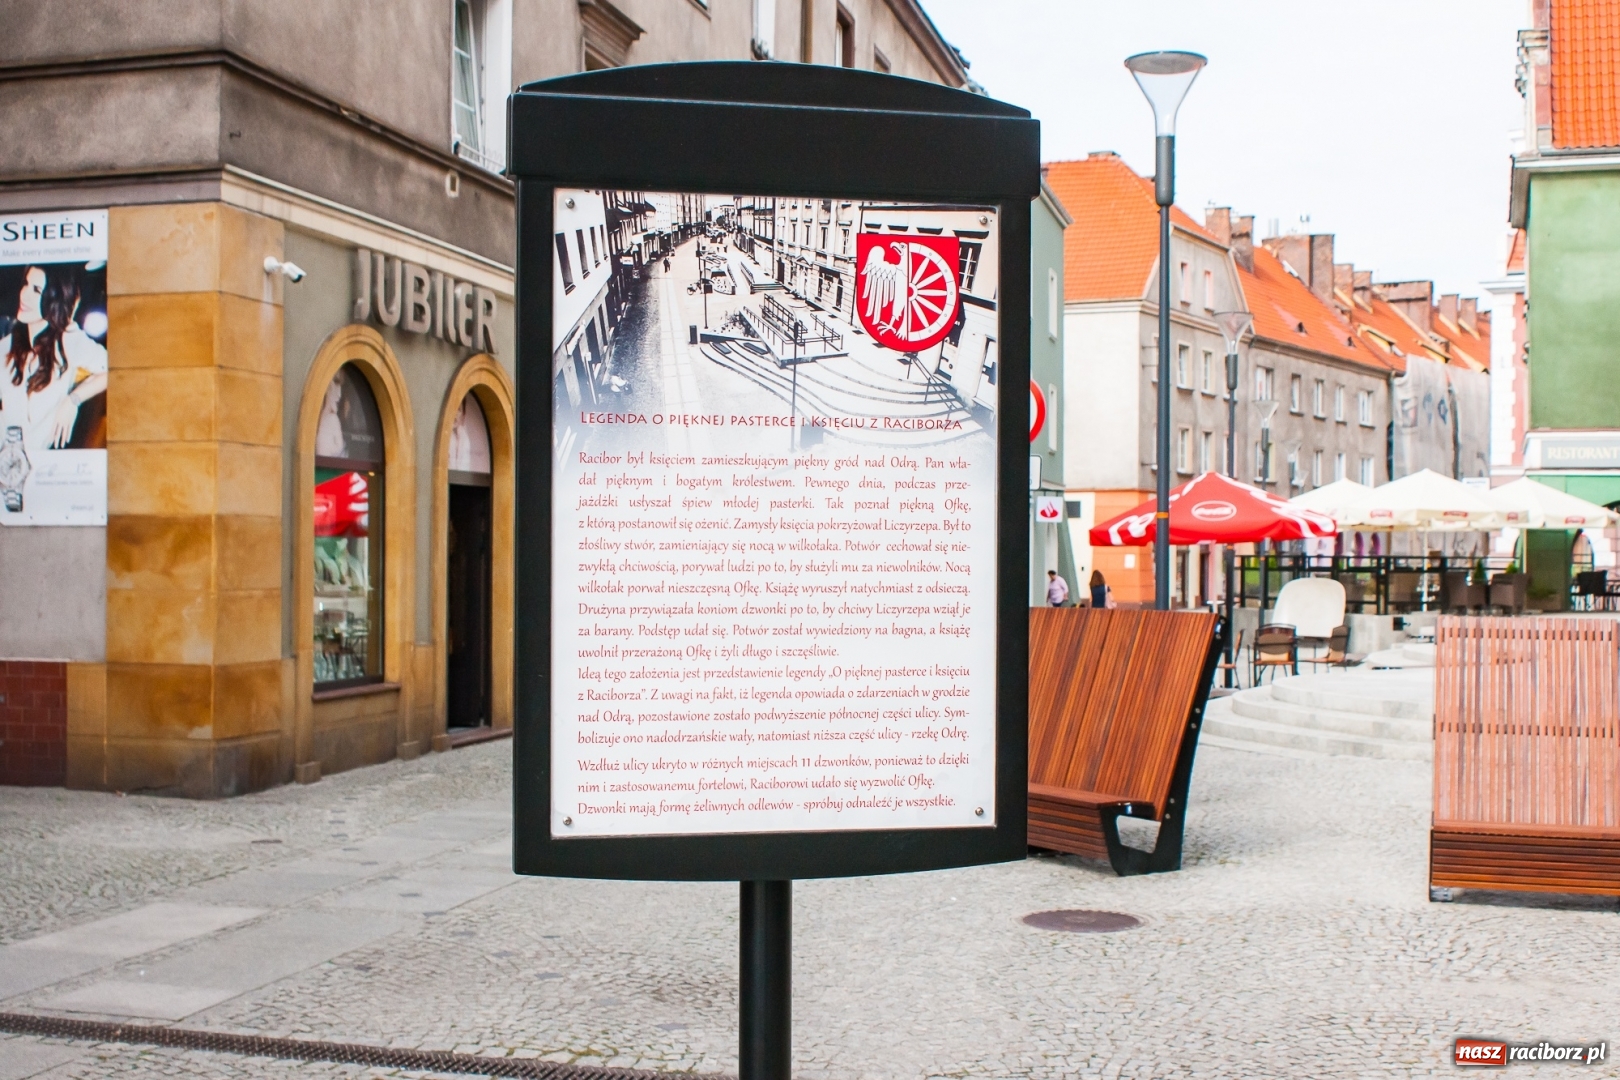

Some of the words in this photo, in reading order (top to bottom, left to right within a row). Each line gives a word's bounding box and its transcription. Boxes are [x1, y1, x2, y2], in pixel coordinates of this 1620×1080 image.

[3, 221, 94, 241] SHEEN
[354, 249, 498, 354] JUBILER
[581, 412, 647, 425] LEGENDA
[653, 414, 663, 424] O
[670, 414, 724, 427] PIĘKNEJ
[731, 415, 795, 426] PASTERCE
[812, 416, 865, 429] KSIĘCIU
[884, 417, 962, 430] RACIBORZA
[579, 451, 622, 464] Racibor
[627, 451, 644, 468] był
[649, 451, 696, 468] księciem
[701, 452, 788, 470] zamieszkującym
[793, 453, 829, 470] piękny
[864, 454, 885, 467] nad
[890, 455, 919, 471] Odrą.
[949, 456, 971, 468] wła-
[606, 472, 652, 489] pięknym
[676, 473, 722, 490] bogatym
[805, 476, 849, 492] Pewnego
[858, 475, 885, 488] dnia,
[894, 475, 936, 492] podczas
[944, 481, 970, 492] prze-
[577, 494, 618, 510] jażdżki
[629, 494, 671, 511] usłyszał
[723, 495, 758, 512] młodej
[769, 495, 814, 512] pasterki.
[854, 496, 889, 512] poznał
[899, 496, 934, 513] piękną
[944, 497, 971, 514] Ofkę,
[617, 515, 677, 532] postanowił
[694, 518, 731, 529] ożenić.
[733, 516, 778, 533] Zamysły
[779, 516, 814, 533] księcia
[816, 517, 882, 534] pokrzyżował
[884, 519, 941, 534] Liczyrzepa.
[943, 518, 960, 534] Był
[658, 539, 729, 554] zamieniający
[749, 542, 774, 554] nocą
[788, 538, 841, 551] wilkołaka.
[885, 538, 932, 551] cechował
[578, 558, 616, 575] zwykłą
[681, 559, 724, 576] porywał
[727, 558, 754, 572] ludzi
[805, 559, 838, 576] służyli
[945, 561, 970, 576] Nocą
[577, 580, 624, 593] wilkołak
[627, 580, 664, 596] porwał
[668, 582, 730, 596] nieszczęsną
[733, 580, 762, 597] Ofkę.
[765, 581, 799, 596] Książę
[801, 580, 847, 597] wyruszył
[850, 580, 913, 597] natychmiast
[925, 580, 970, 596] odsieczą.
[578, 602, 626, 618] Drużyna
[629, 601, 694, 618] przywiązała
[697, 601, 738, 614] koniom
[741, 601, 786, 614] dzwonki
[838, 601, 873, 618] chciwy
[876, 602, 930, 618] Liczyrzepa
[933, 601, 959, 617] wziął
[594, 623, 634, 640] barany.
[638, 622, 680, 639] Podstęp
[684, 622, 708, 636] udał
[711, 624, 728, 639] się.
[772, 622, 803, 635] został
[805, 622, 872, 639] wywiedziony
[891, 622, 926, 639] bagna,
[939, 622, 970, 638] książę
[577, 644, 618, 657] uwolnił
[621, 646, 682, 661] przerażoną
[685, 643, 712, 661] Ofkę
[720, 643, 739, 661] żyli
[741, 643, 772, 660] długo
[578, 666, 601, 682] Ideą
[604, 668, 626, 683] tego
[629, 665, 680, 678] założenia
[681, 667, 701, 681] jest
[703, 665, 783, 681] przedstawienie
[785, 664, 826, 681] legendy
[844, 664, 882, 681] pięknej
[884, 666, 927, 680] pasterce
[935, 663, 970, 679] księciu
[661, 688, 693, 703] uwagi
[711, 686, 736, 701] fakt,
[751, 686, 792, 703] legenda
[794, 685, 845, 702] opowiada
[856, 684, 919, 698] zdarzeniach
[931, 684, 970, 701] grodzie
[578, 709, 599, 722] nad
[603, 708, 634, 725] Odrą,
[638, 710, 710, 725] pozostawione
[713, 707, 750, 720] zostało
[754, 706, 826, 724] podwyższenie
[915, 705, 940, 722] ulicy.
[944, 706, 969, 721] Sym-
[577, 730, 620, 748] bolizuje
[728, 728, 754, 745] wały,
[757, 730, 810, 741] natomiast
[813, 729, 846, 740] niższa
[877, 726, 902, 743] ulicy
[911, 726, 938, 742] rzekę
[941, 725, 969, 741] Odrę.
[577, 757, 620, 771] Wzdłuż
[622, 757, 649, 774] ulicy
[651, 756, 687, 773] ukryto
[746, 754, 798, 772] miejscach
[874, 754, 923, 769] ponieważ
[938, 751, 969, 768] dzięki
[609, 780, 695, 792] zastosowanemu
[697, 776, 746, 793] fortelowi,
[750, 776, 808, 789] Raciborowi
[811, 775, 841, 788] udało
[859, 774, 905, 791] wyzwolić
[907, 774, 935, 790] Ofkę.
[578, 800, 626, 814] Dzwonki
[629, 802, 656, 817] mają
[658, 799, 691, 815] formę
[693, 798, 745, 815] żeliwnych
[905, 793, 955, 810] wszystkie.
